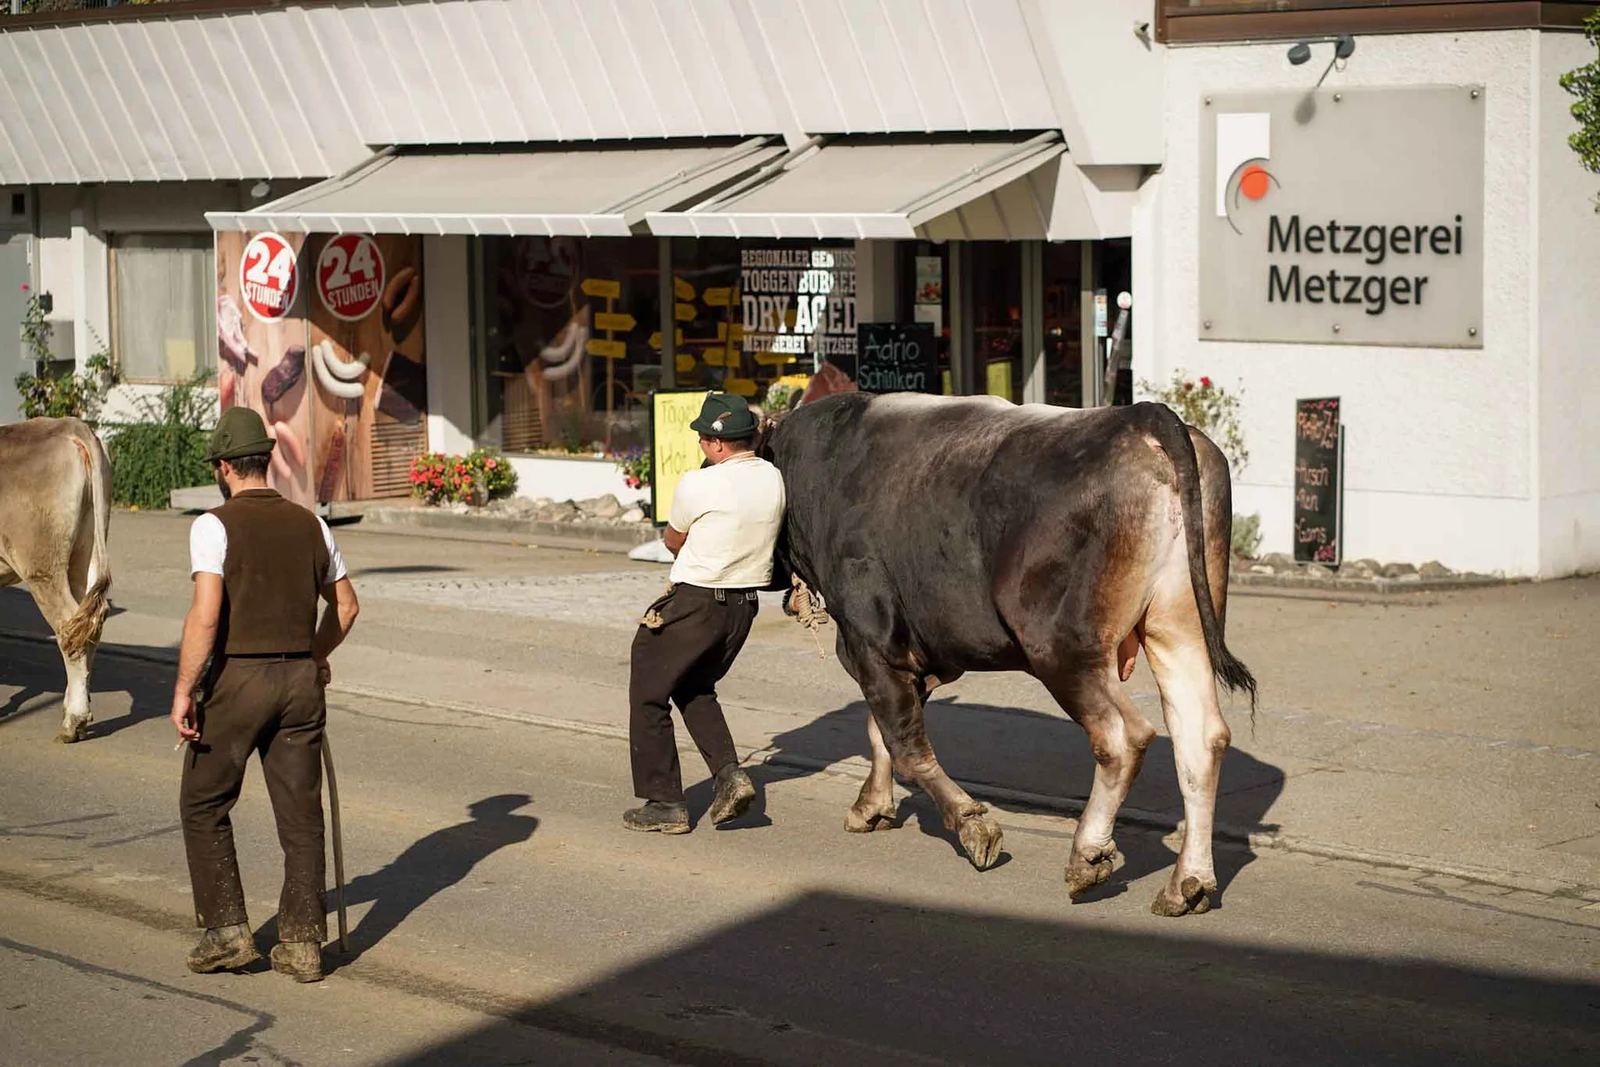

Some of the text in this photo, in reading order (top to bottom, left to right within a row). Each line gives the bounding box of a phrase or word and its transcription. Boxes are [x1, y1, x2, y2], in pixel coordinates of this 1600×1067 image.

[1267, 214, 1463, 265] Metzgerei
[246, 240, 292, 290] 24
[323, 238, 377, 290] 24
[741, 250, 856, 268] REGIONALER GENUSS
[245, 282, 290, 310] STUNDEN
[327, 279, 379, 309] STUNDEN
[741, 270, 856, 293] TOGGENBURGER
[1267, 264, 1429, 316] Metzger
[742, 295, 857, 334] DRY AGED
[743, 335, 805, 353] METZGEREI
[864, 333, 919, 360] Adrio
[859, 365, 925, 390] Schinken
